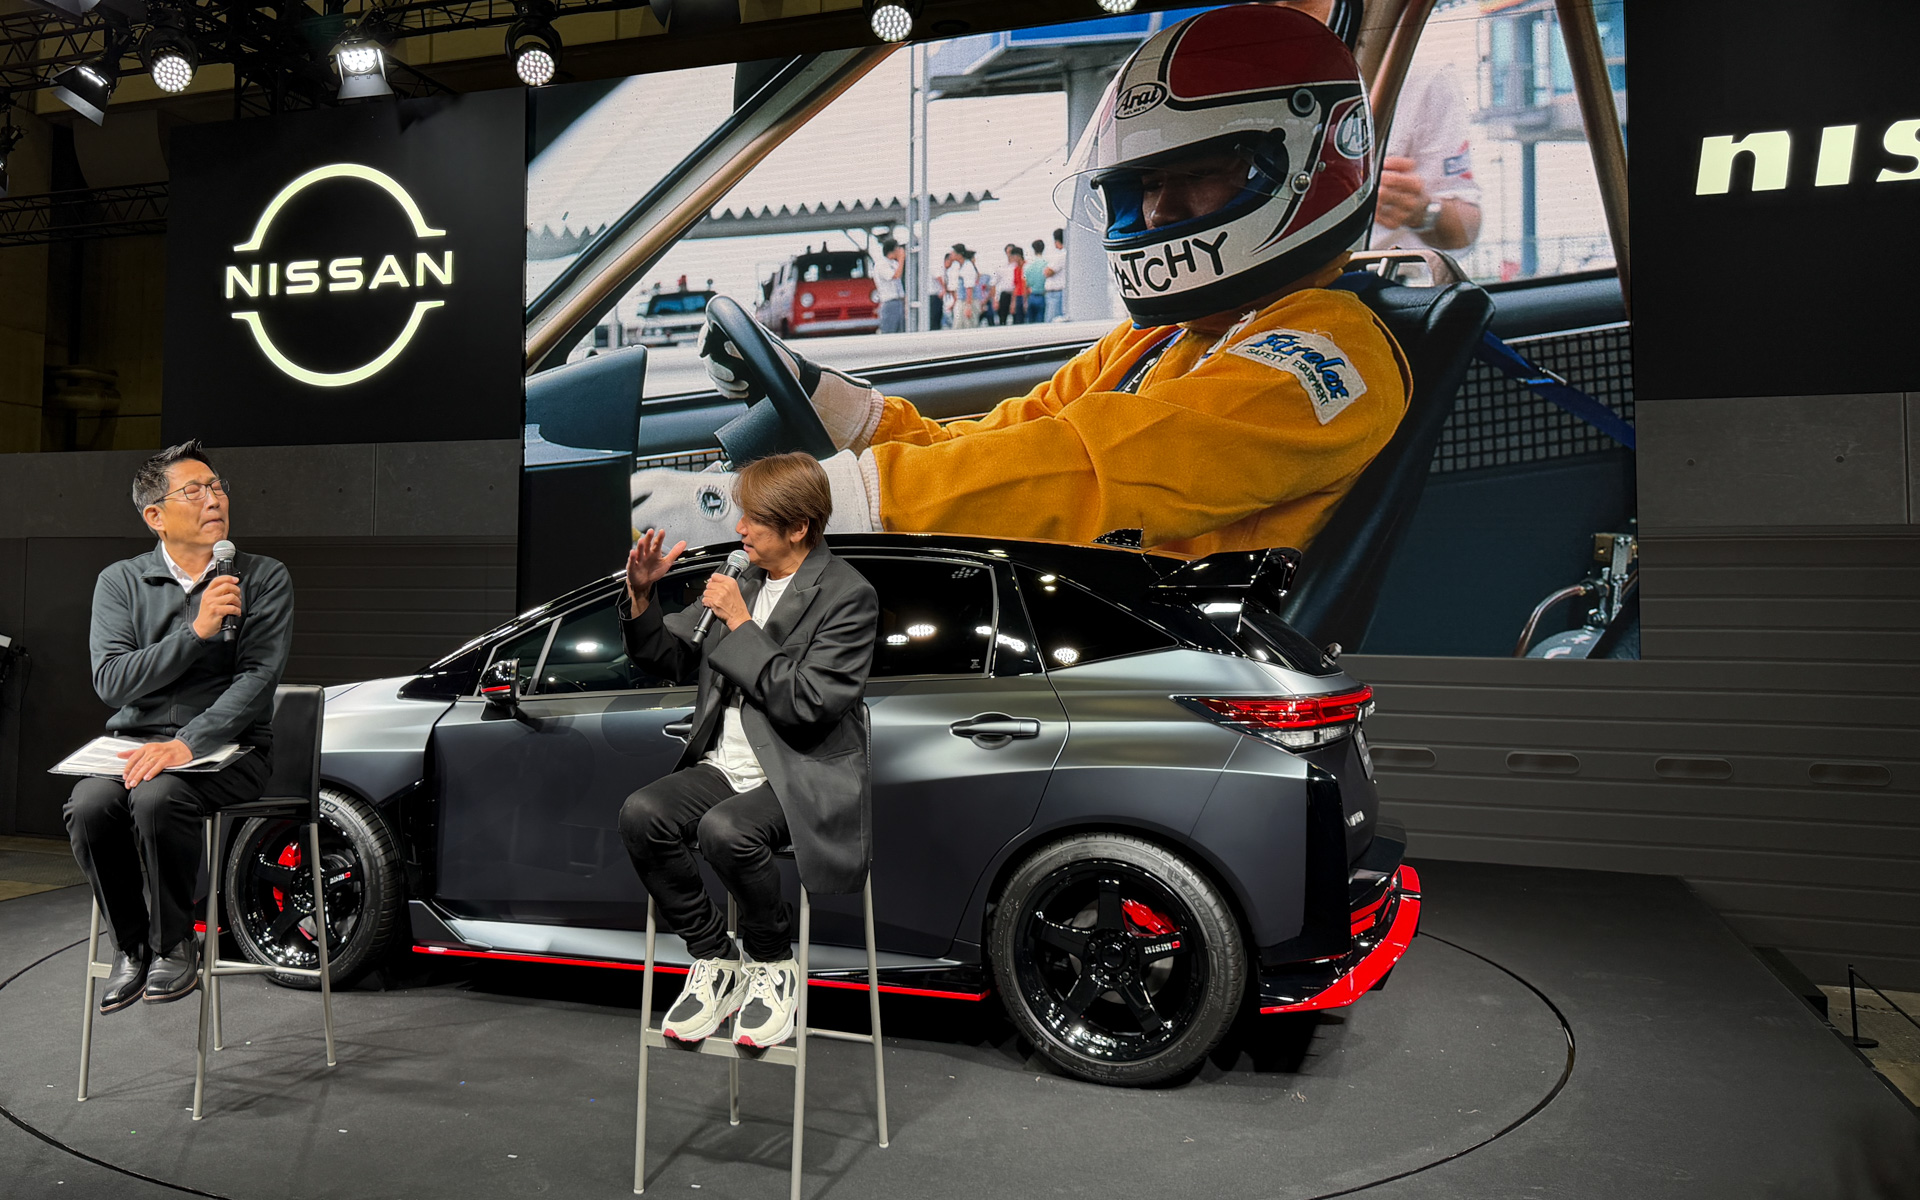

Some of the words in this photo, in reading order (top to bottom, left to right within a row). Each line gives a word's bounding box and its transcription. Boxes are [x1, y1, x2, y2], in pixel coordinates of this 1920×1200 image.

[1117, 85, 1160, 112] Arai
[226, 251, 452, 298] NISSAN
[1246, 347, 1288, 363] SAFETY
[1291, 360, 1329, 406] EQUIPMENT
